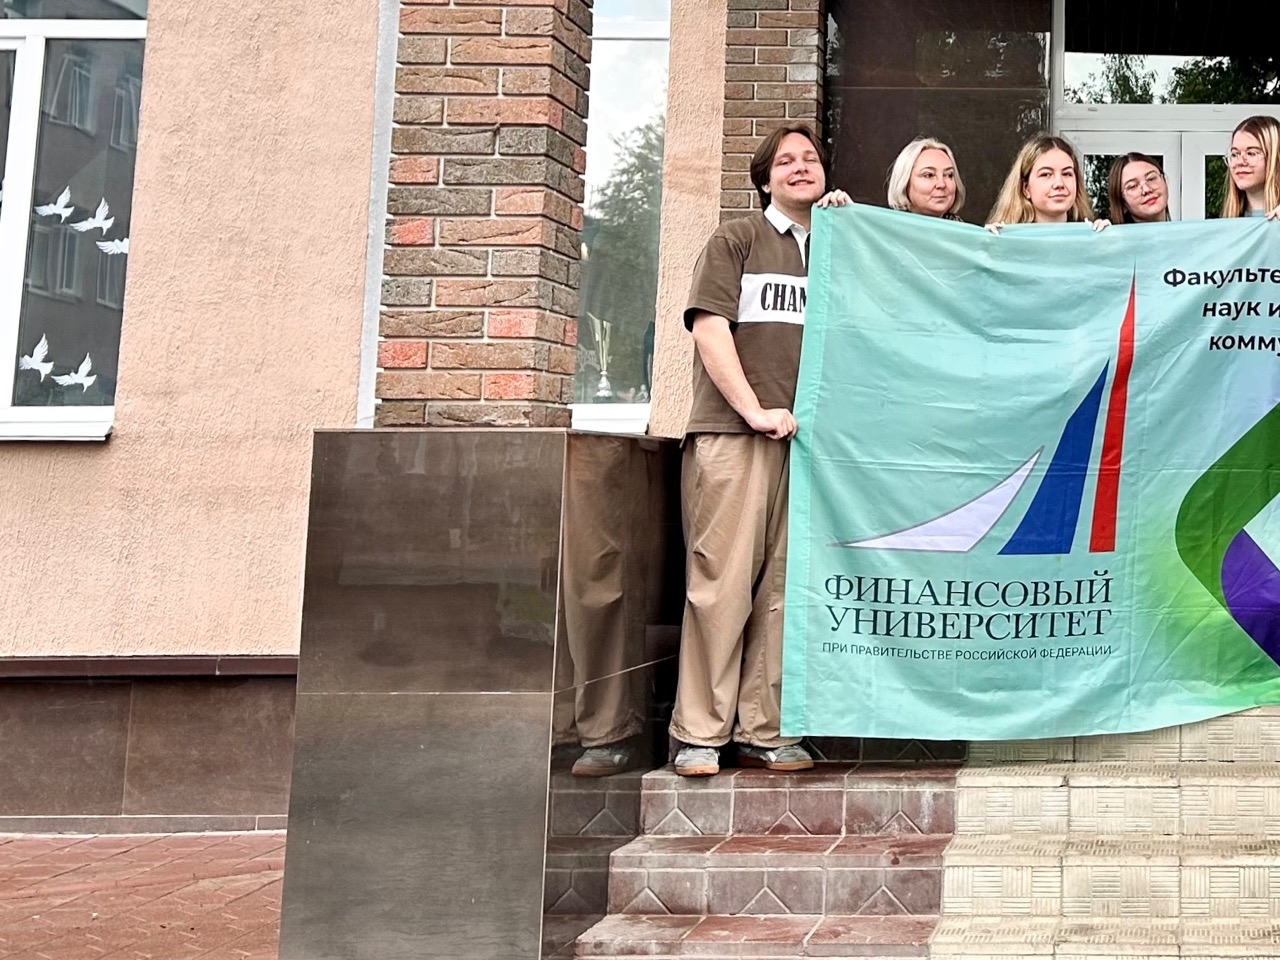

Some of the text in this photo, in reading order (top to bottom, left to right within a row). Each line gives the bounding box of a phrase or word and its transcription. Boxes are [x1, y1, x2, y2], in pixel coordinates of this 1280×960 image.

[1202, 300, 1262, 322] наук
[824, 569, 1114, 608] ФИНАНСОВЫЙ
[825, 605, 1113, 641] УНИВЕРСИТЕТ
[822, 642, 1112, 661] ПРИ ПРАВИТЕЛЬСТВЕ РОССИЙСКОЙ ФЕДЕРАЦИИ
